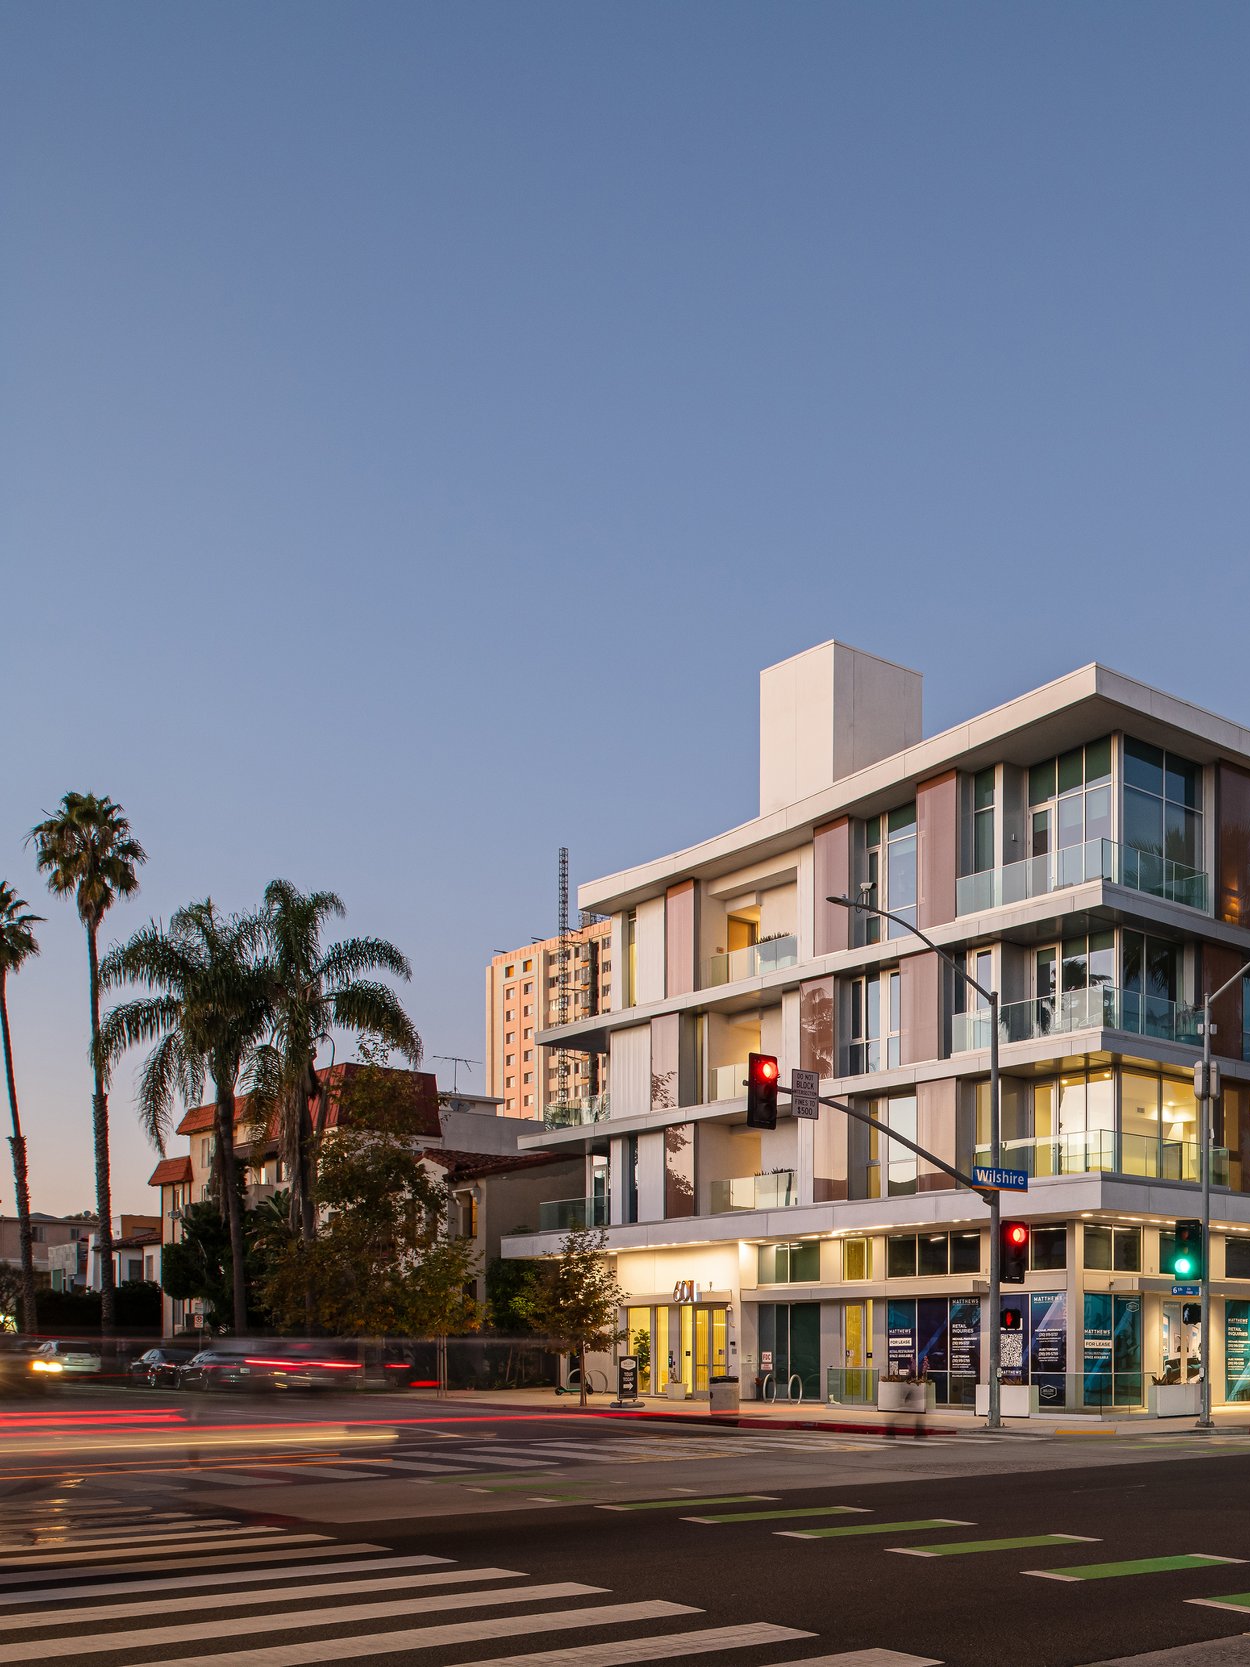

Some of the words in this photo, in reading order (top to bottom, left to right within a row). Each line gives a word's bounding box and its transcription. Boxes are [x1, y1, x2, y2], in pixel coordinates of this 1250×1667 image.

[796, 1081, 814, 1090] BLOCK
[798, 1107, 813, 1116] $500
[976, 1169, 1024, 1185] Wilshire
[673, 1280, 695, 1302] 601
